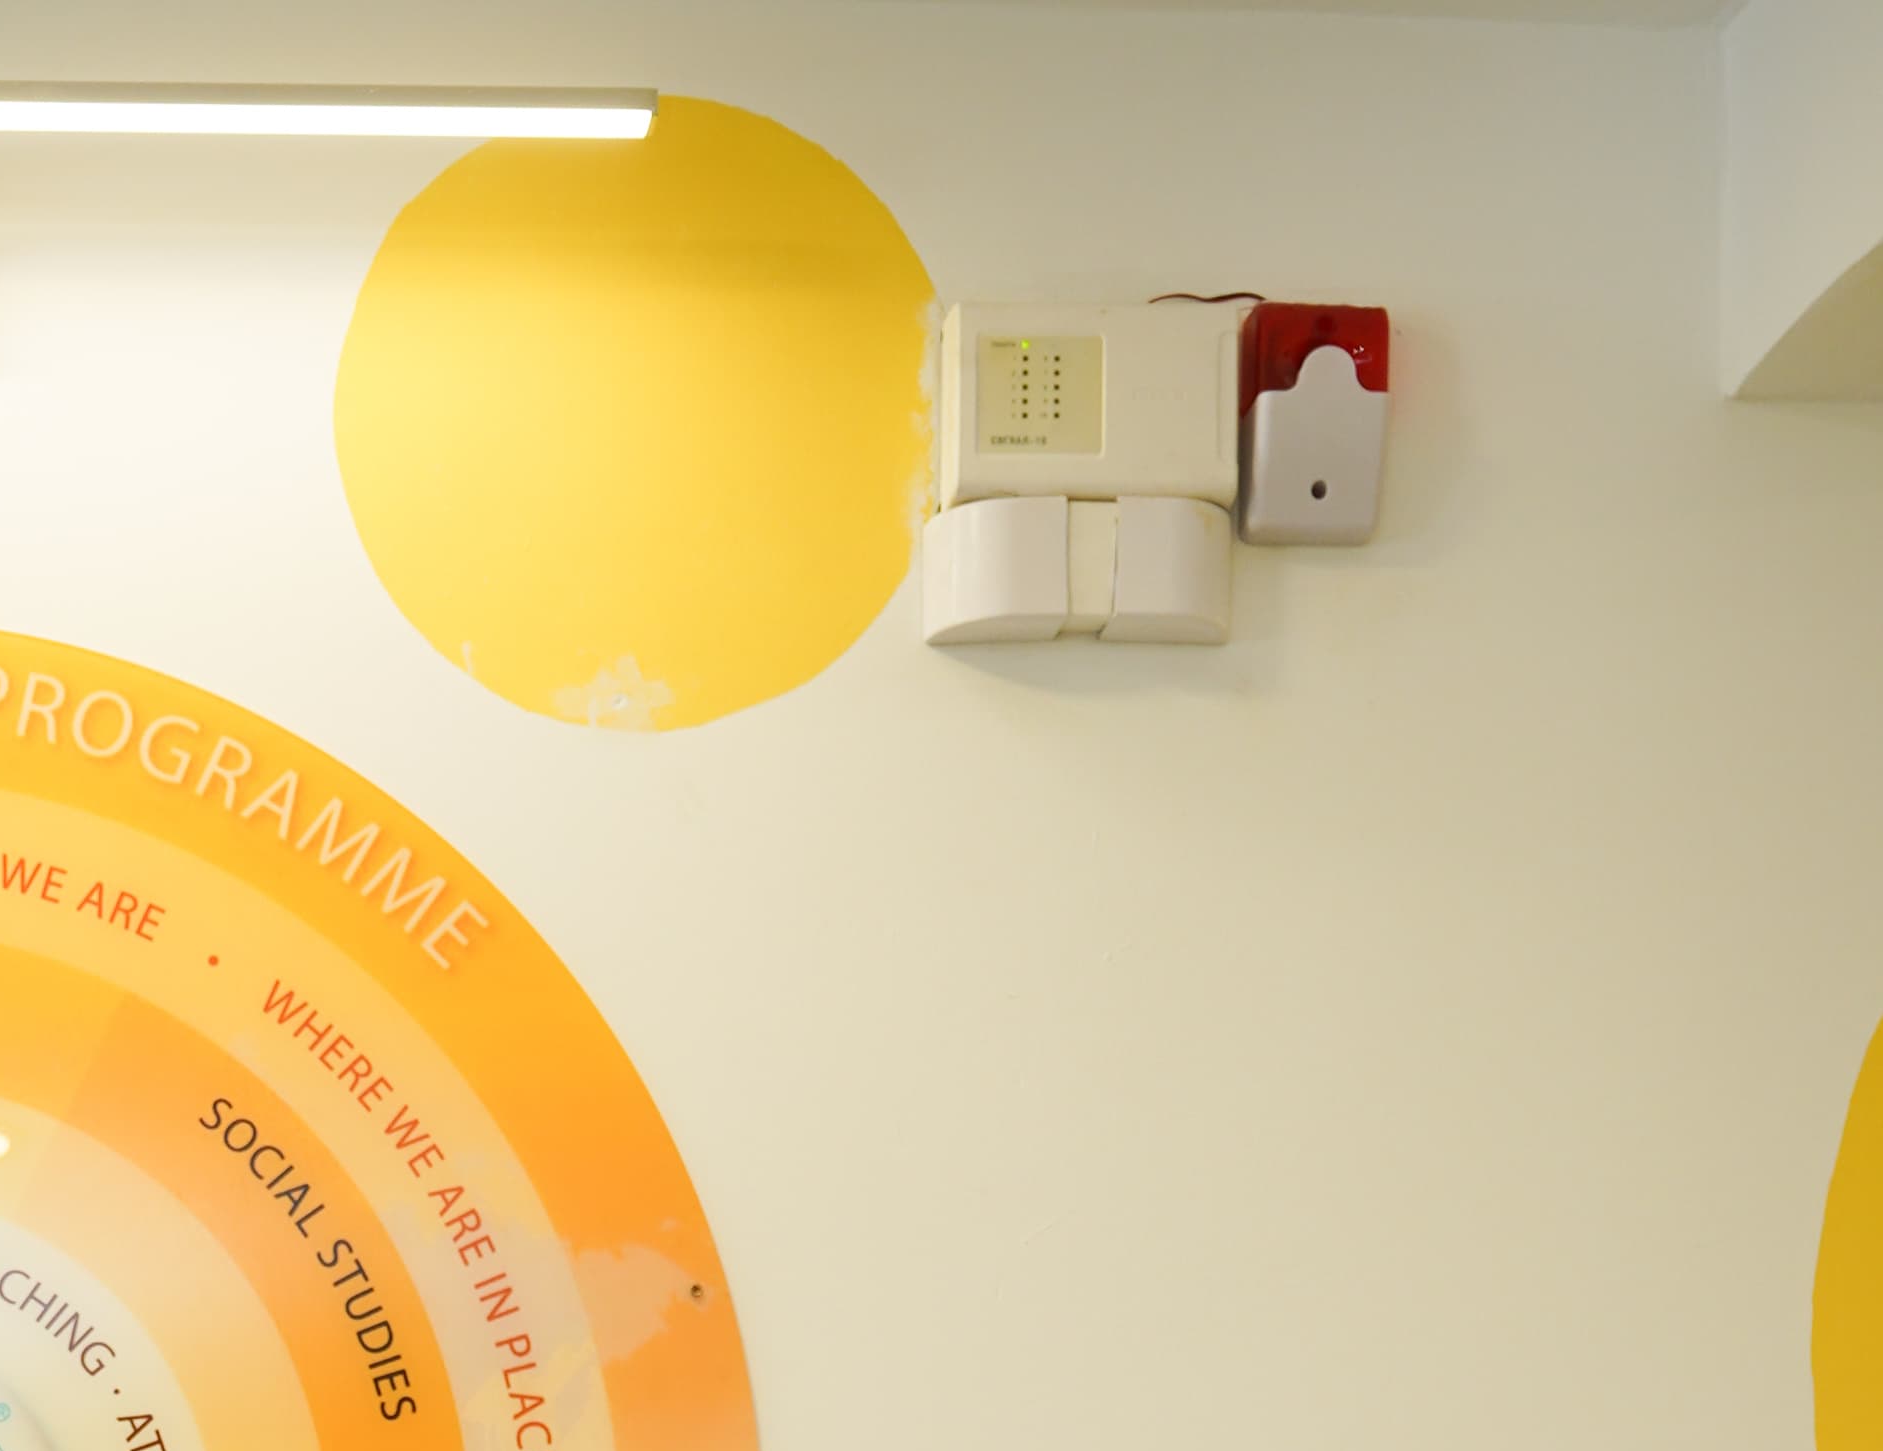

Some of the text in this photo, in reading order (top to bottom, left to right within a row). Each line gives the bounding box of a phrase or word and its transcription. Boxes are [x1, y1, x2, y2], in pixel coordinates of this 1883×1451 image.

[0, 851, 69, 904] WE
[75, 881, 167, 943] ARE
[198, 1097, 417, 1422] SOCIAL STUDIES
[261, 978, 394, 1113] WHERE
[383, 1105, 445, 1178] WE
[428, 1185, 496, 1267] ARE
[473, 1272, 521, 1323] IN
